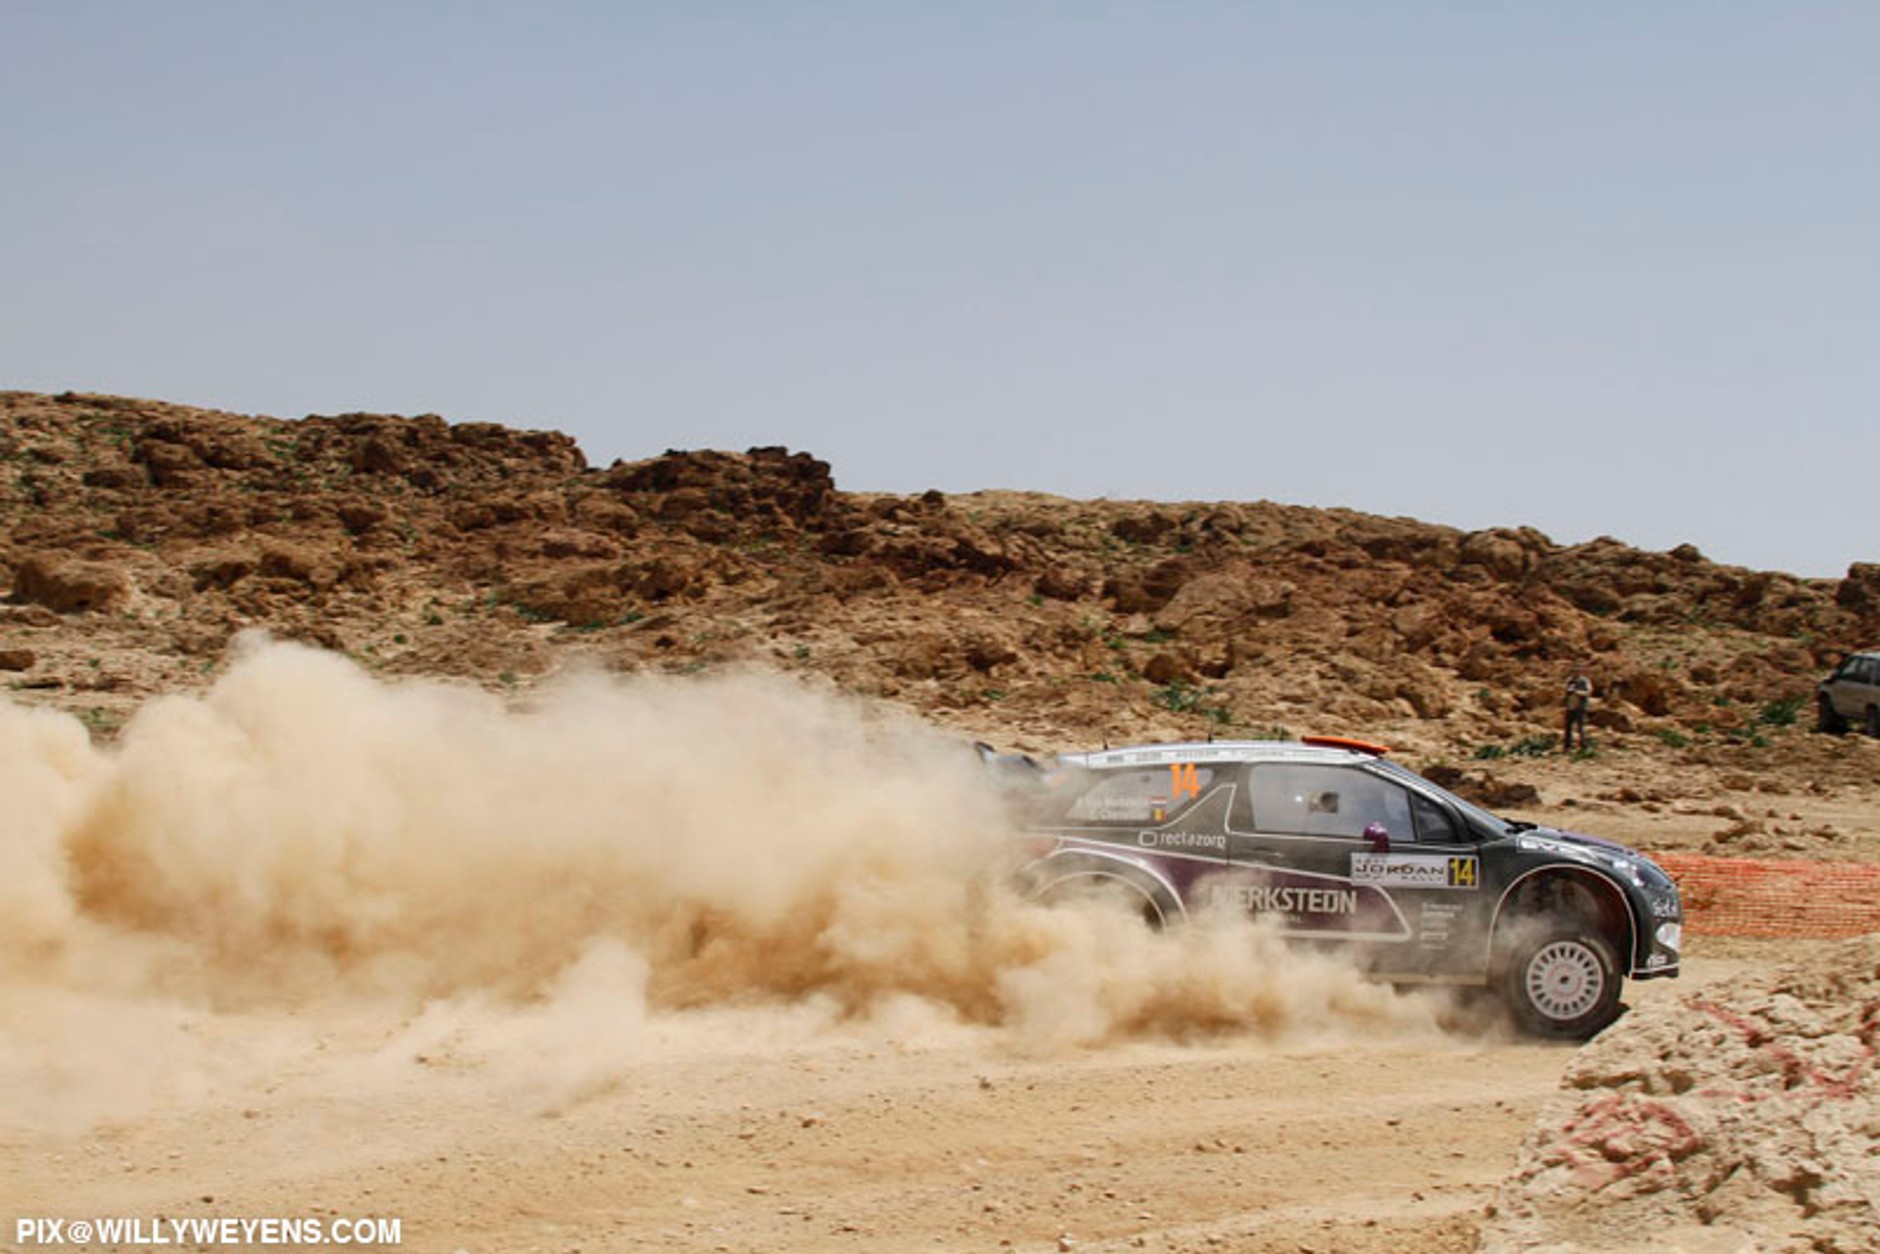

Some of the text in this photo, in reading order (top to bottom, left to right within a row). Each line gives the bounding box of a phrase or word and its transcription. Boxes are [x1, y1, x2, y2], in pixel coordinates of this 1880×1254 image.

[1169, 762, 1200, 799] 14
[1356, 863, 1445, 875] JORDAN
[1449, 857, 1475, 885] 14
